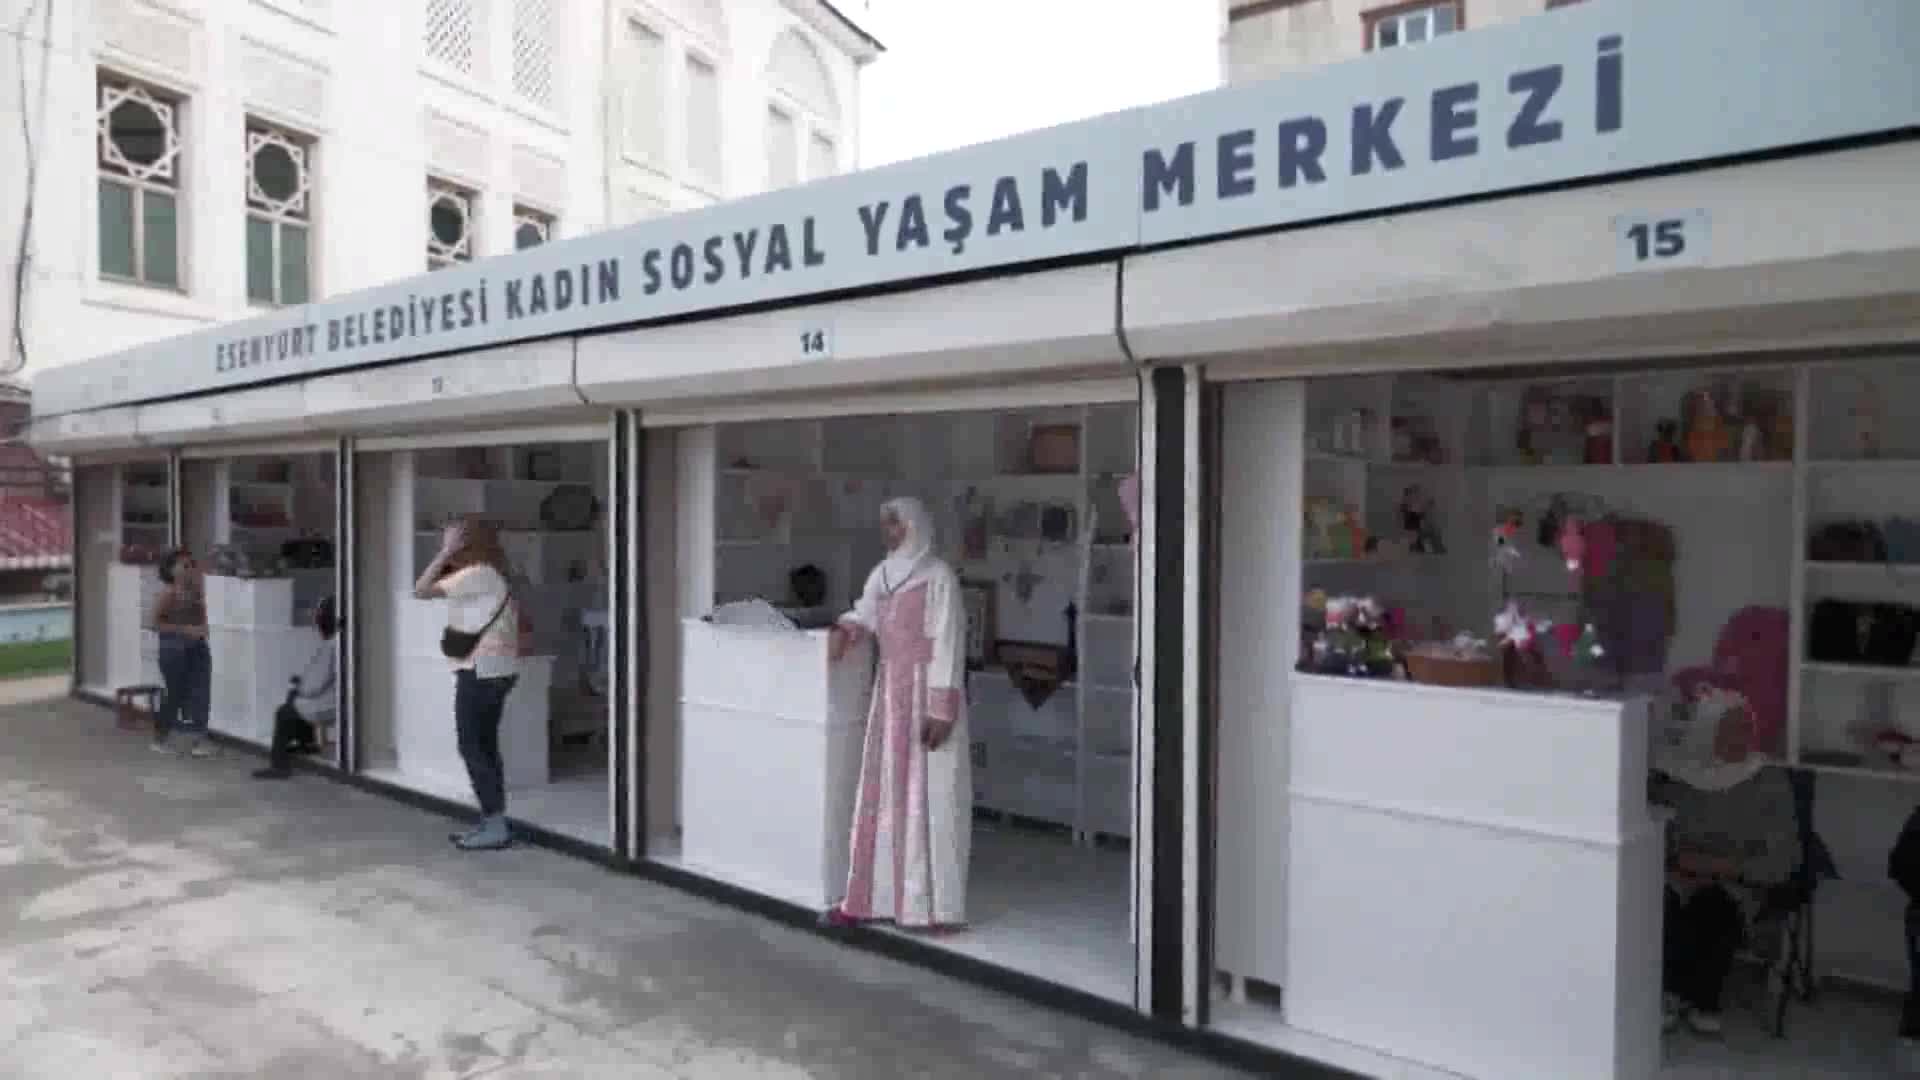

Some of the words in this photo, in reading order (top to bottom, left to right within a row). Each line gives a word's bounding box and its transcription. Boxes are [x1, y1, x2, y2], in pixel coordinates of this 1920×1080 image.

[326, 278, 489, 352] BELEDİYESİ
[505, 258, 622, 320] KADIN
[642, 216, 825, 296] SOSYAL
[858, 160, 1089, 255] YAŞAM
[1141, 34, 1624, 213] MERKEZİ
[1626, 219, 1686, 262] 15
[800, 330, 824, 354] 14
